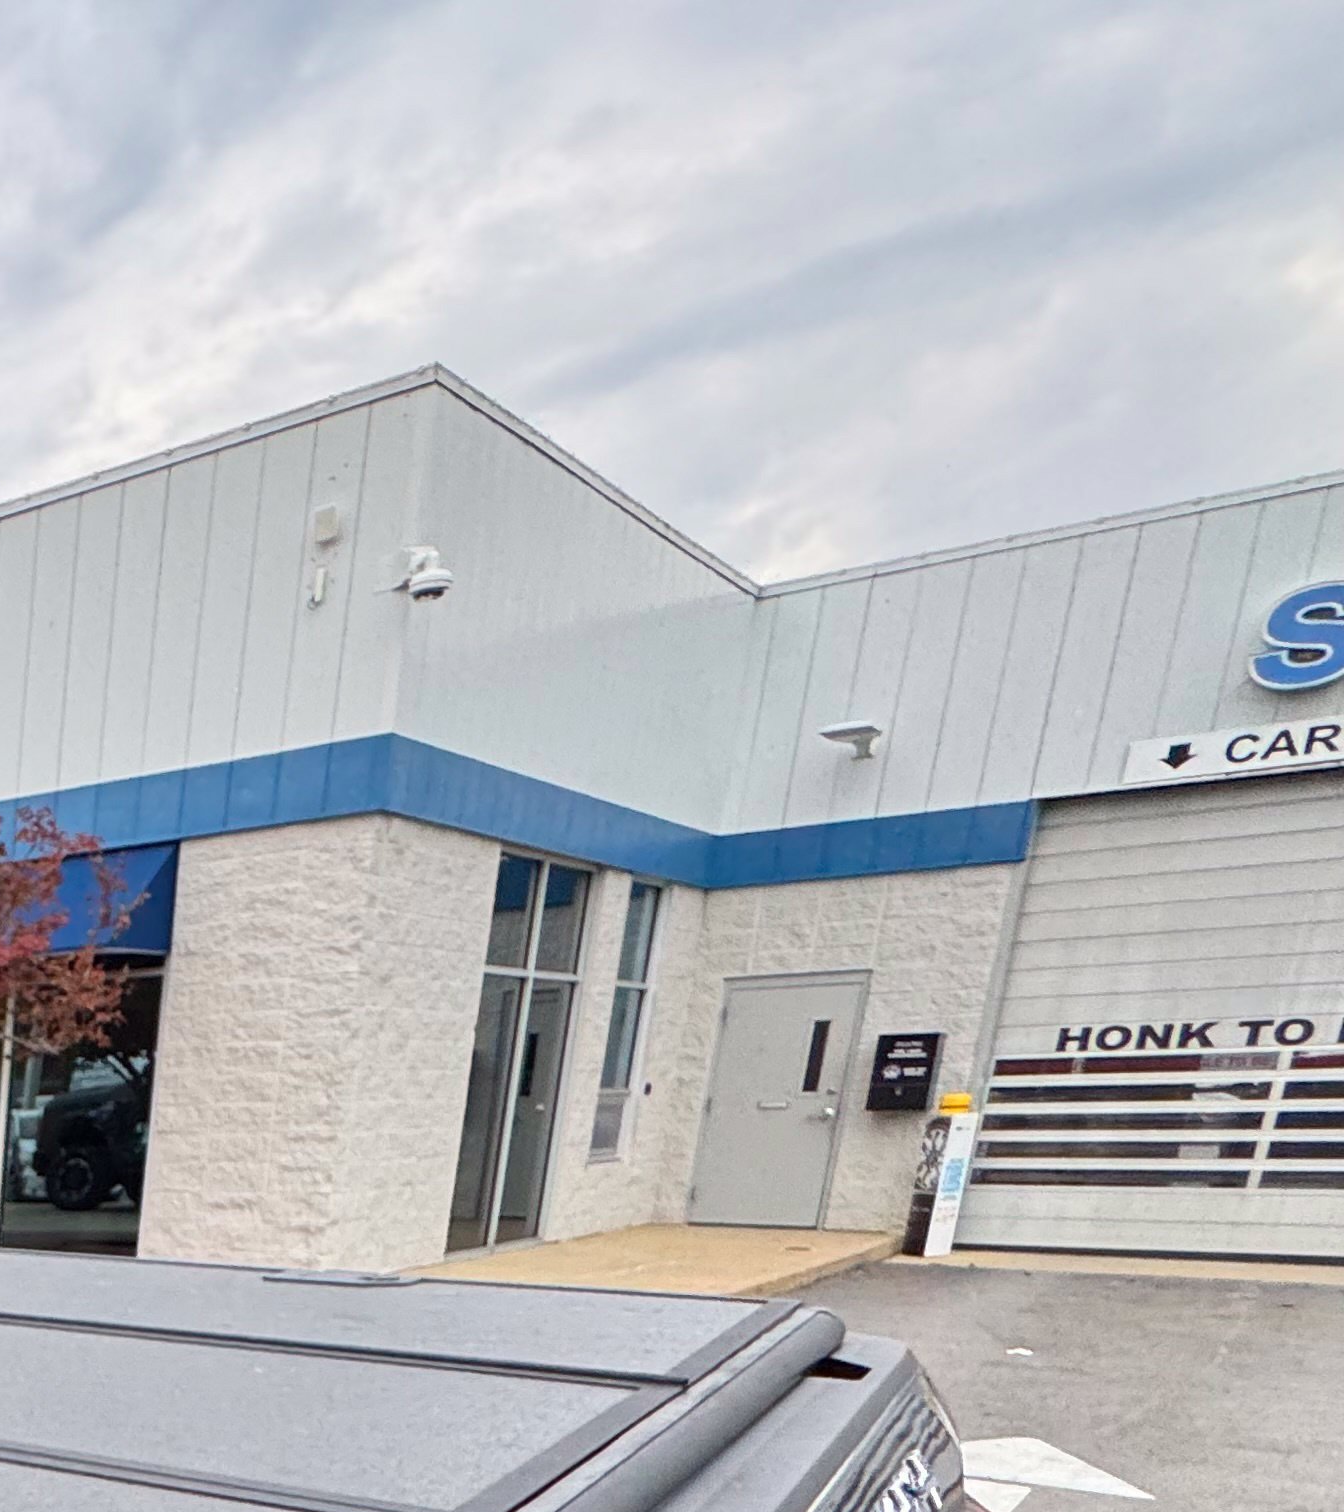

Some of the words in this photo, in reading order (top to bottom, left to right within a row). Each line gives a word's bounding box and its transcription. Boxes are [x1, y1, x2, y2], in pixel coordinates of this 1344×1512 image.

[1225, 724, 1342, 764] CAR
[1055, 1021, 1219, 1052] HONK
[1238, 1018, 1315, 1047] TO
